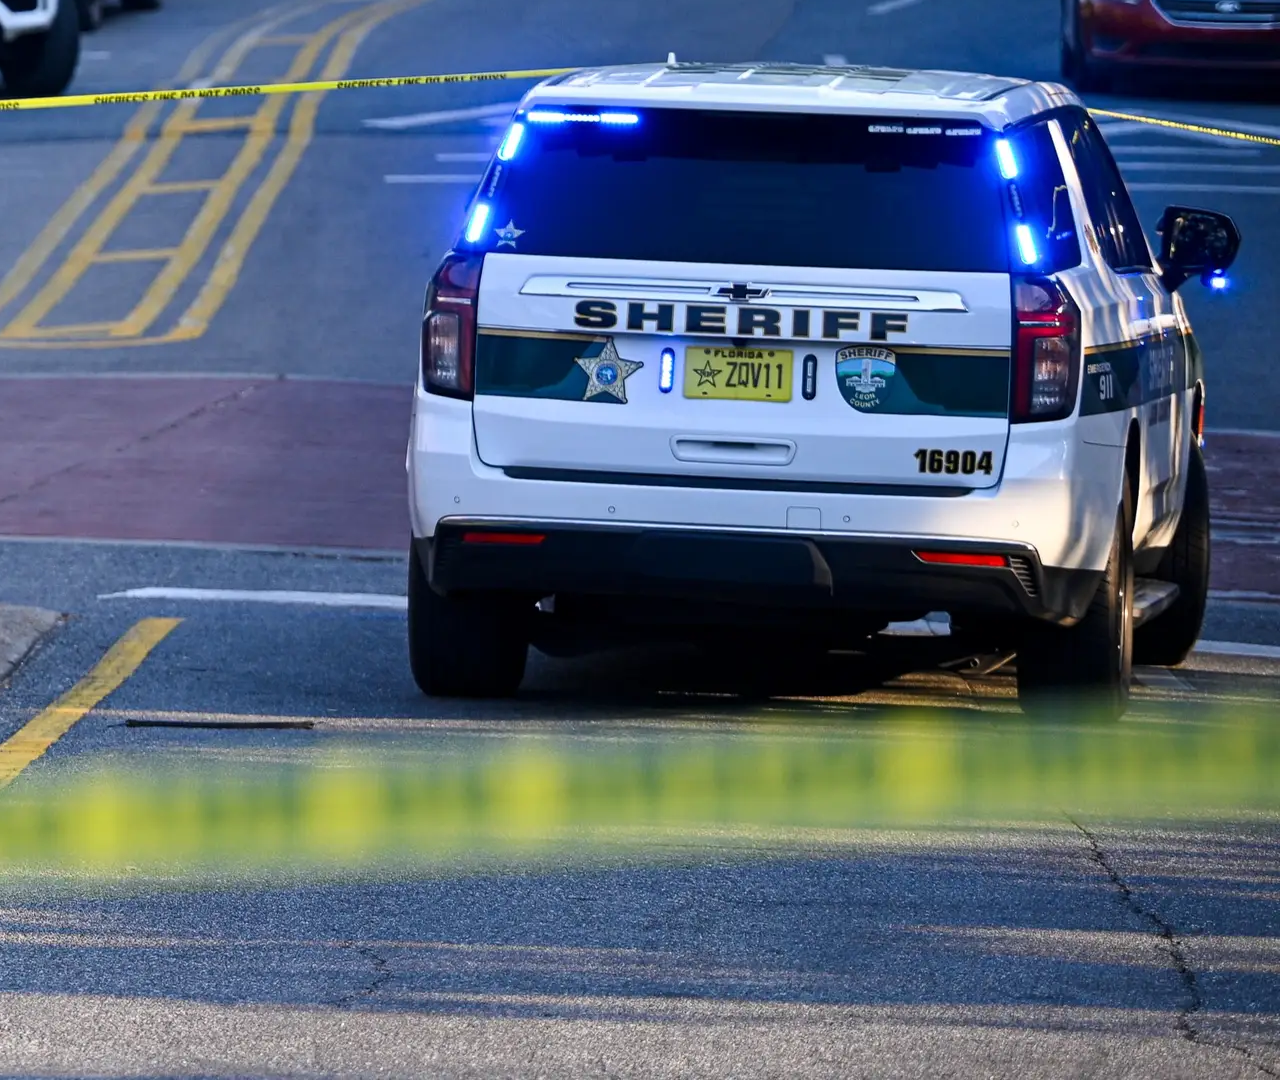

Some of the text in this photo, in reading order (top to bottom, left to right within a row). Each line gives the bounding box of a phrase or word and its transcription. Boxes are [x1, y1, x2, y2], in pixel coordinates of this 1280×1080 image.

[574, 299, 909, 342] SHERIFF
[714, 350, 764, 359] FLORIDA
[839, 347, 893, 360] SHERIFF
[725, 361, 783, 389] ZQV11
[854, 392, 876, 400] LEON
[1099, 374, 1114, 400] 911
[849, 398, 881, 408] COUNTY
[913, 448, 993, 476] 16904
